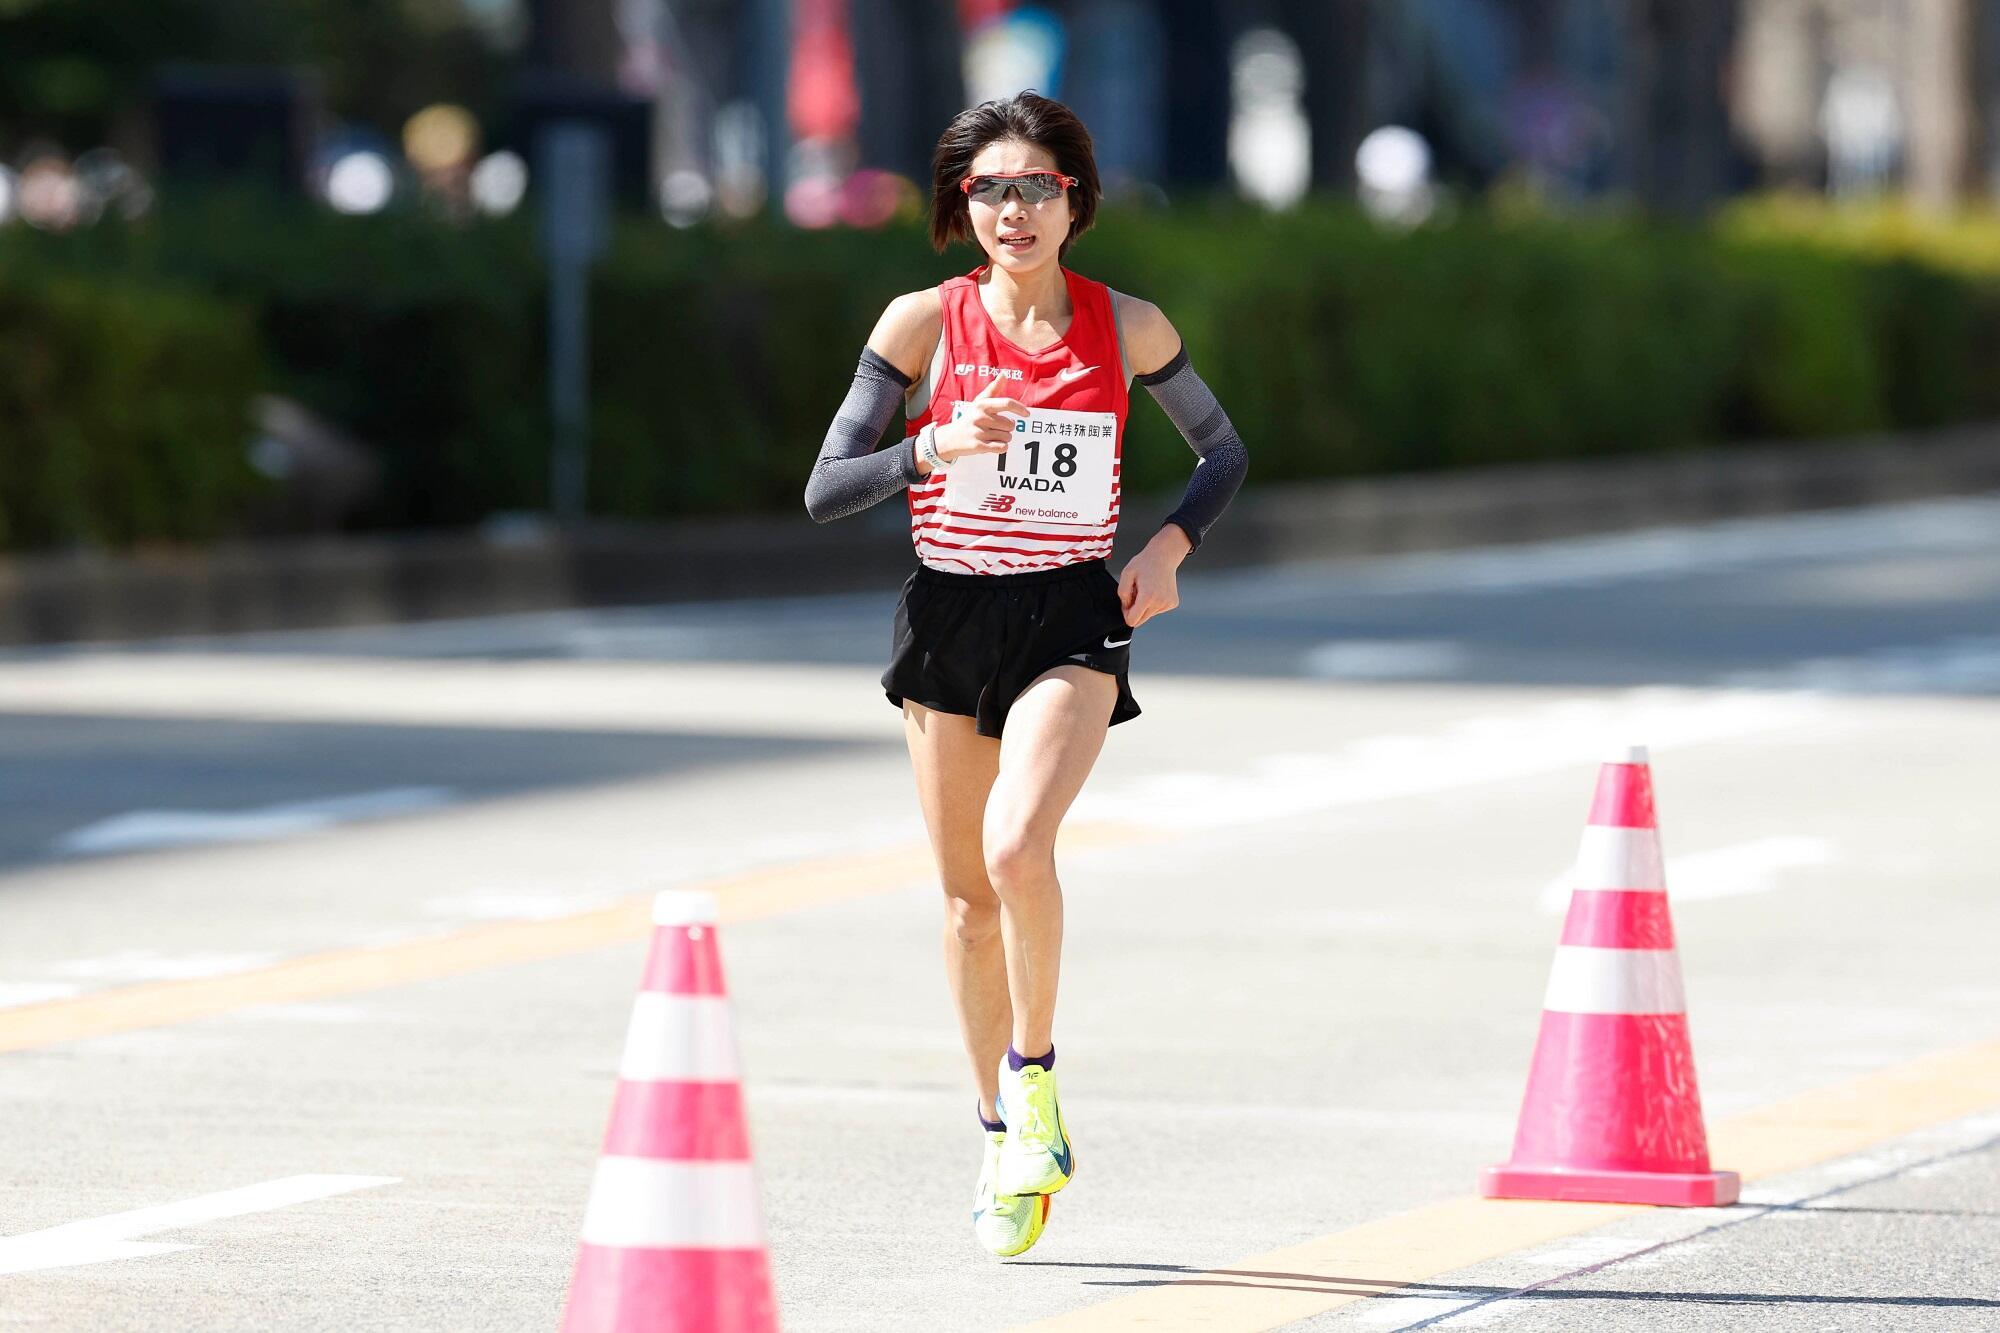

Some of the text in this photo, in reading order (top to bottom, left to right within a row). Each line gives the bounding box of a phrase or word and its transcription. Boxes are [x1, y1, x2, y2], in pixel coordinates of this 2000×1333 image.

[1032, 421, 1112, 438] 日本特殊陶業
[999, 475, 1065, 493] WADA
[1015, 508, 1035, 516] new
[1038, 509, 1078, 519] balance
